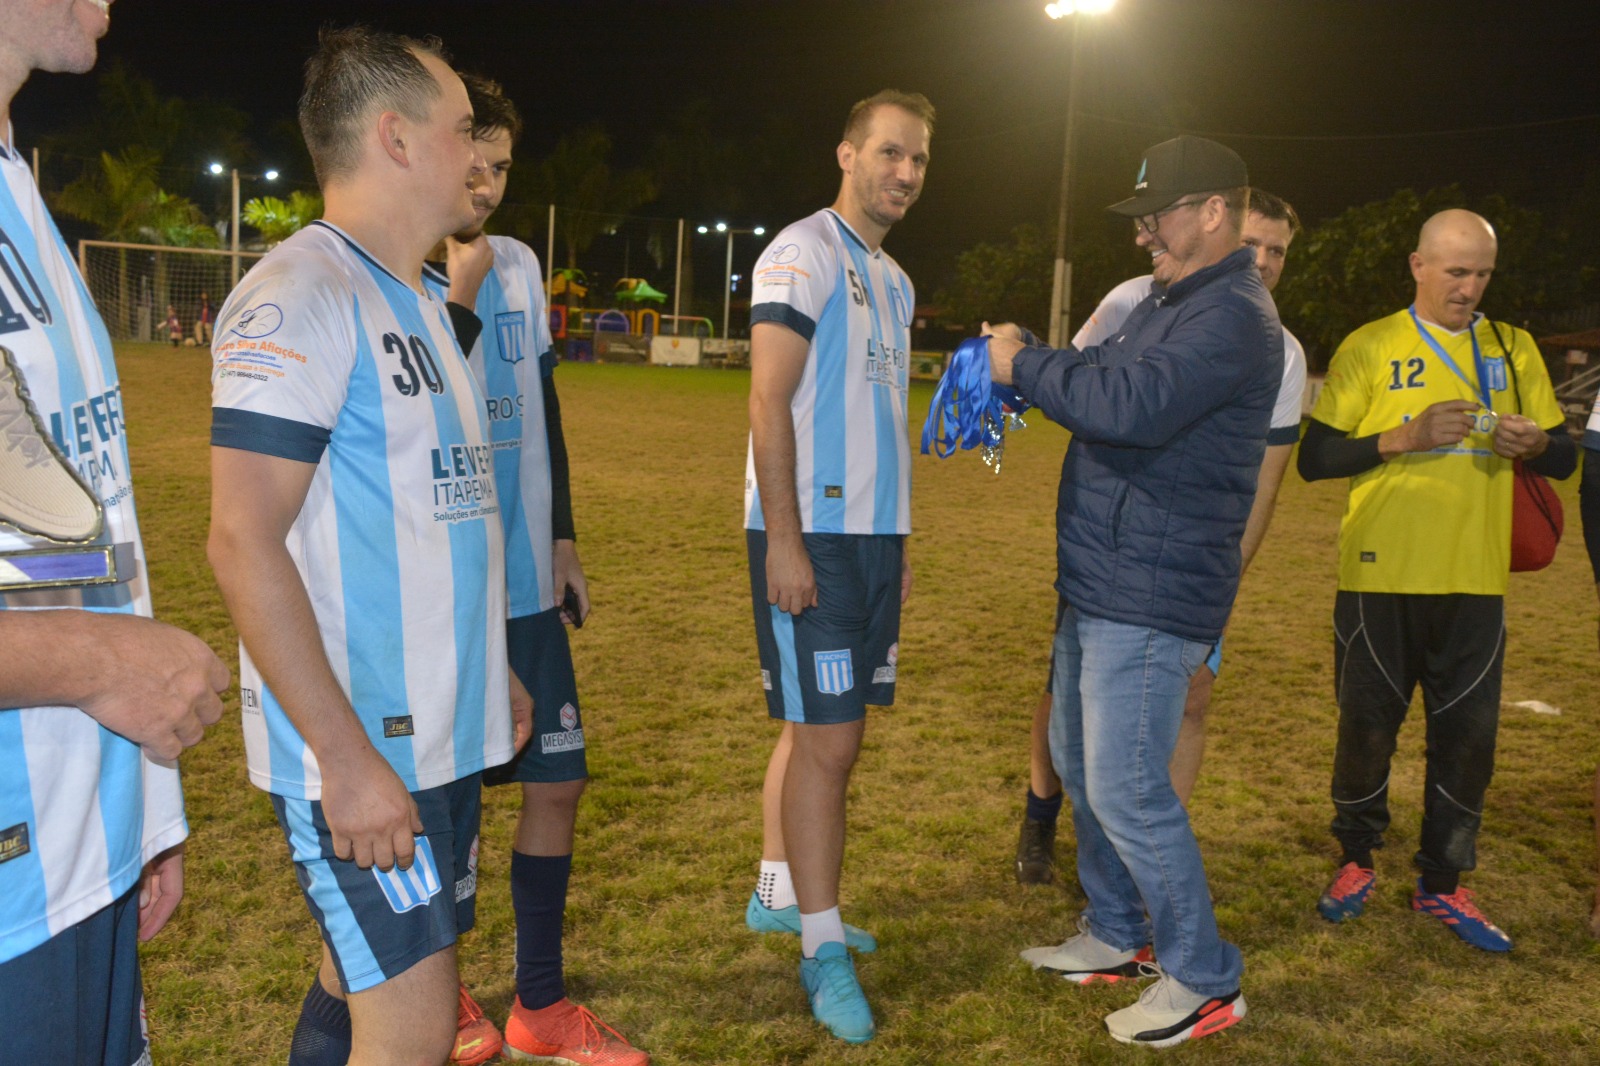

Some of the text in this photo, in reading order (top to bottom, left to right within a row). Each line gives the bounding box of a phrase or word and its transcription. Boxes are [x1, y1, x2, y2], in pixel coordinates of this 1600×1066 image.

[259, 340, 307, 363] Afiações
[382, 331, 444, 397] 30
[1389, 357, 1425, 391] 12
[433, 509, 469, 523] Soluções
